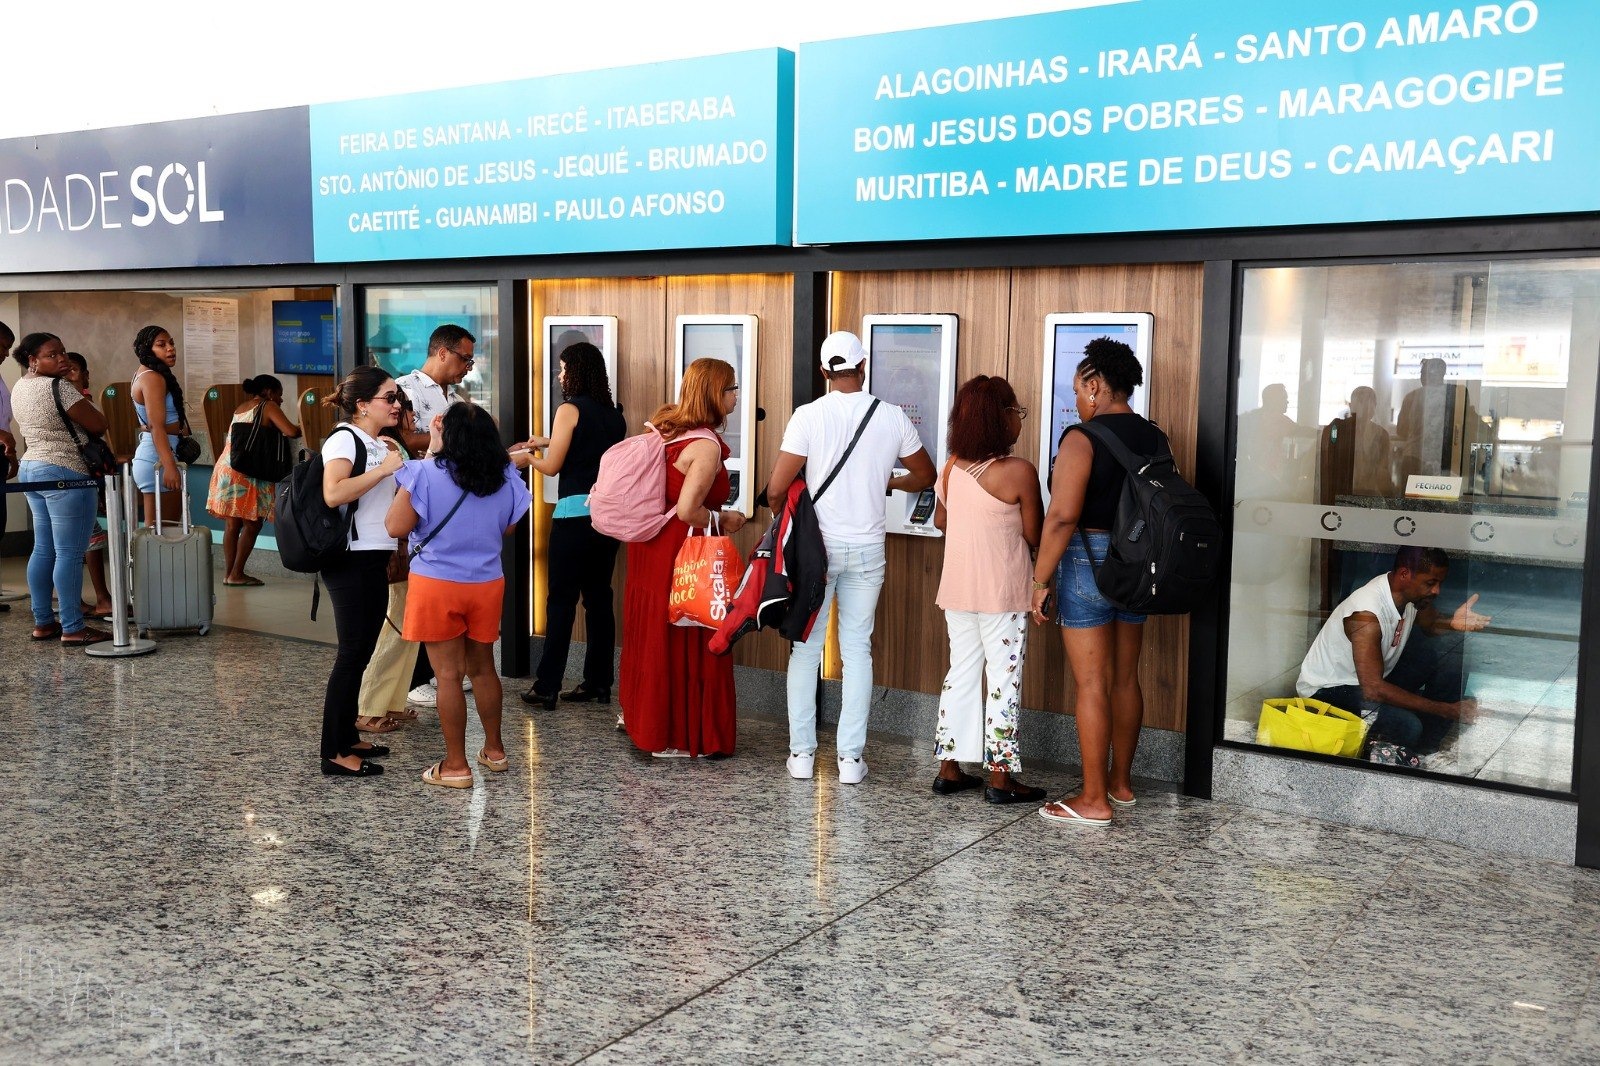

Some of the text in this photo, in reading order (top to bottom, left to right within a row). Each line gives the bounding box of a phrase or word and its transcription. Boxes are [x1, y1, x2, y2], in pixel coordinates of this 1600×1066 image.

[875, 56, 1068, 99] ALAGOINHAS
[1098, 33, 1202, 78] IRARÁ
[1236, 22, 1366, 63] SANTO
[1375, 0, 1538, 48] AMARO
[341, 132, 389, 154] FEIRA
[394, 128, 417, 149] DE
[423, 120, 511, 147] SANTANA
[528, 106, 588, 137] IRECÊ
[608, 95, 735, 129] ITABERABA
[855, 124, 914, 152] BOM
[923, 115, 1016, 147] JESUS
[1027, 108, 1092, 139] DOS
[1103, 95, 1243, 133] POBRES
[1279, 63, 1564, 118] MARAGOGIPE
[320, 175, 356, 195] STO.
[360, 165, 438, 192] ANTÔNIO
[445, 165, 468, 186] DE
[474, 159, 536, 184] JESUS
[554, 146, 628, 178] JEQUIÉ
[649, 140, 767, 171] BRUMADO
[857, 170, 989, 201] MURITIBA
[1016, 161, 1127, 192] MADRE
[1139, 157, 1183, 186] DE
[1195, 149, 1291, 183] DEUS
[1328, 129, 1553, 174] CAMAÇARI
[0, 161, 224, 233] DADE SOL
[349, 205, 420, 232] CAETITÉ
[436, 202, 537, 228] GUANAMBI
[556, 197, 625, 221] PAULO
[630, 190, 724, 217] AFONSO
[106, 388, 116, 396] 02
[1415, 482, 1453, 491] FECHADO
[675, 573, 699, 587] com
[710, 560, 727, 621] Skala
